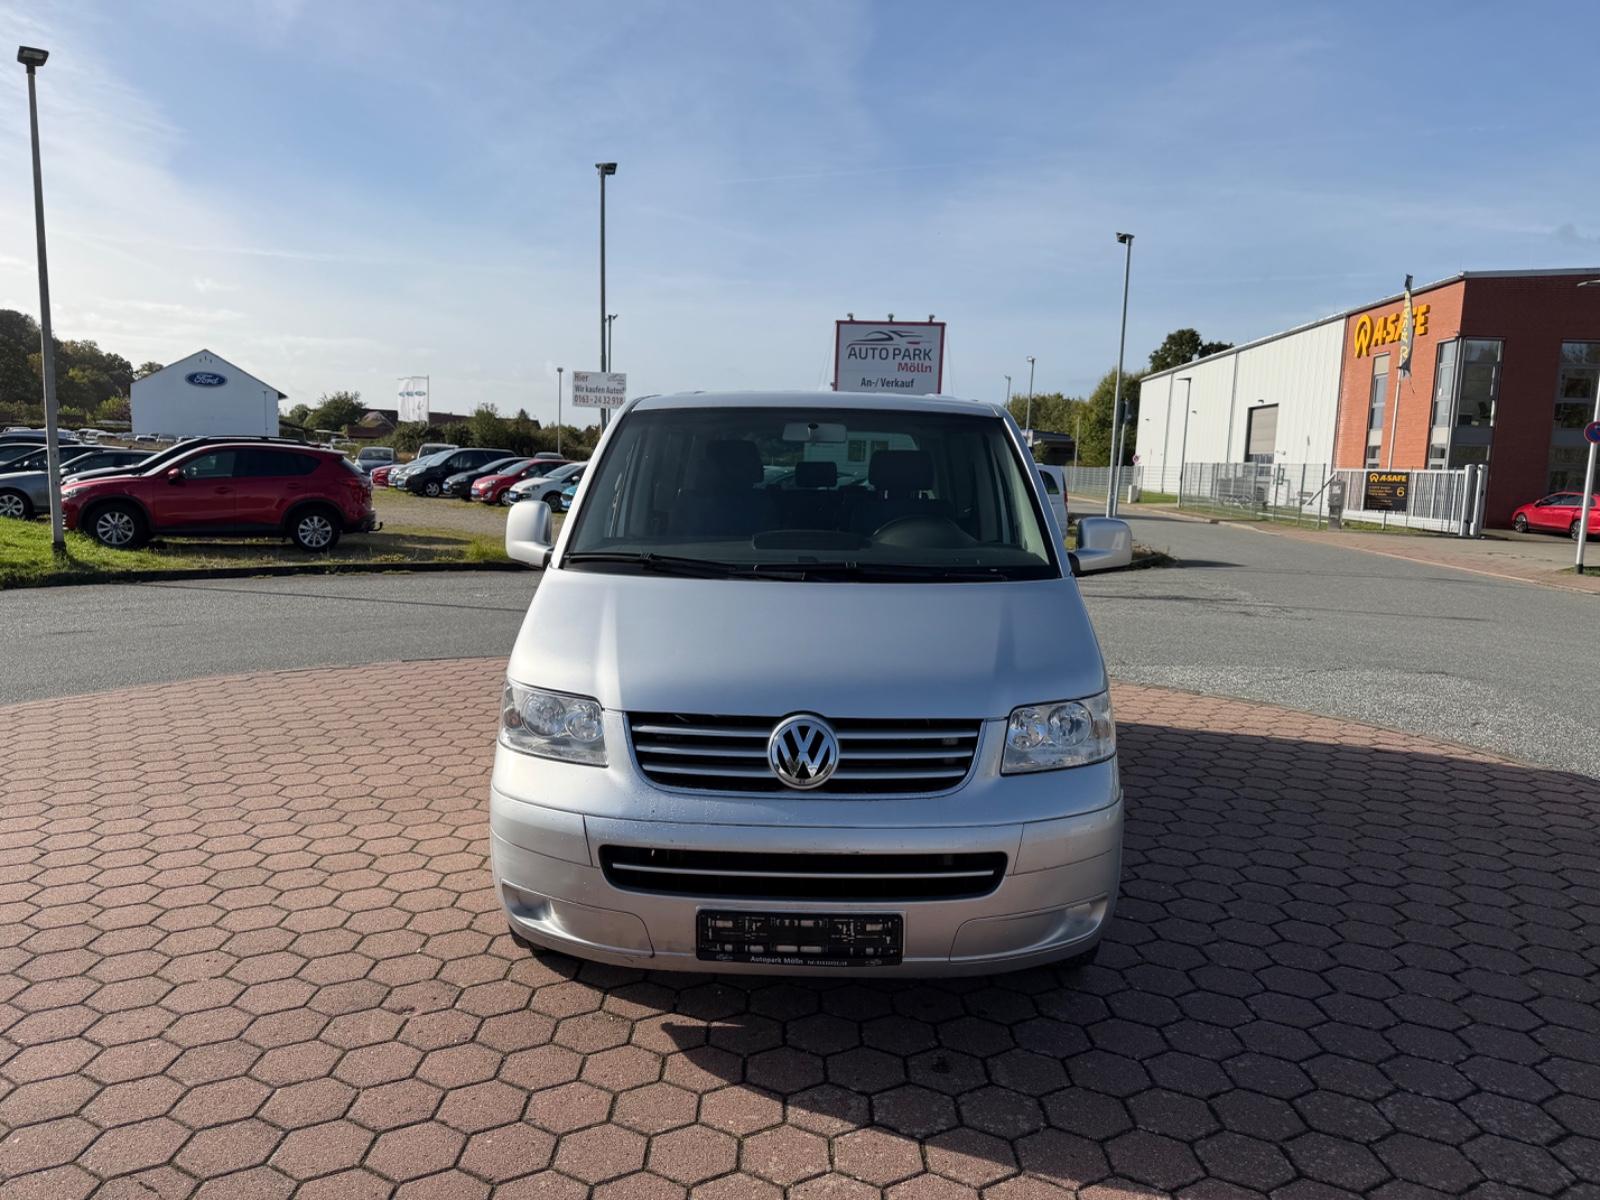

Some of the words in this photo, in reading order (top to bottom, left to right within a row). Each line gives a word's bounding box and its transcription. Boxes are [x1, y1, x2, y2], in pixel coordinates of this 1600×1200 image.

[847, 347, 889, 360] AUTO
[892, 347, 933, 361] PARK
[896, 362, 933, 373] Mölln
[574, 373, 589, 382] Hier
[880, 377, 915, 388] Verkauf
[574, 384, 585, 393] Wir
[585, 384, 606, 394] kaufen
[1396, 486, 1405, 497] 6
[772, 719, 835, 783] VW
[750, 955, 782, 964] Autopark
[783, 956, 804, 965] Mölln
